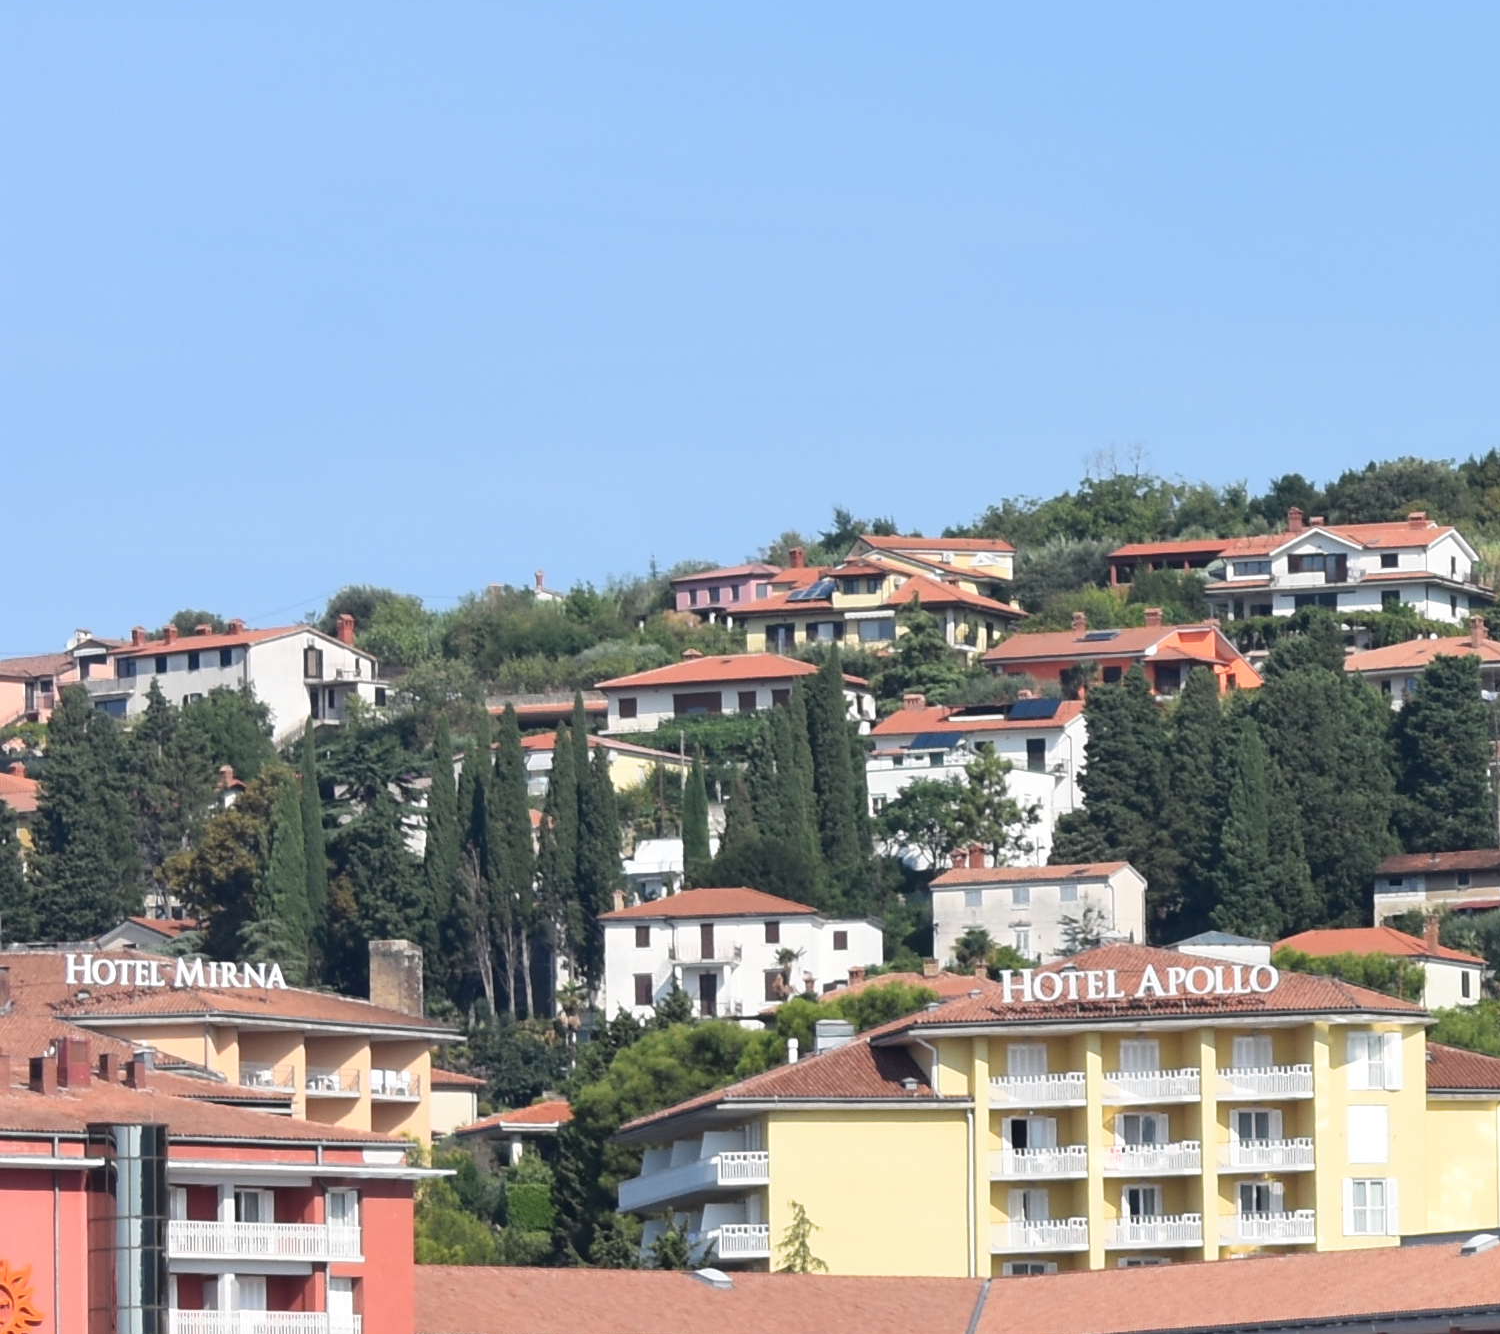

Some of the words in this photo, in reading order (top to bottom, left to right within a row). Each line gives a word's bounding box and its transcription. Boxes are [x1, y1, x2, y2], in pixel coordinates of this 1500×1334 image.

[66, 954, 165, 985] HOTEL
[174, 958, 289, 989] MIRNA
[999, 968, 1125, 1003] HOTEL
[1134, 964, 1280, 997] APOLLO
